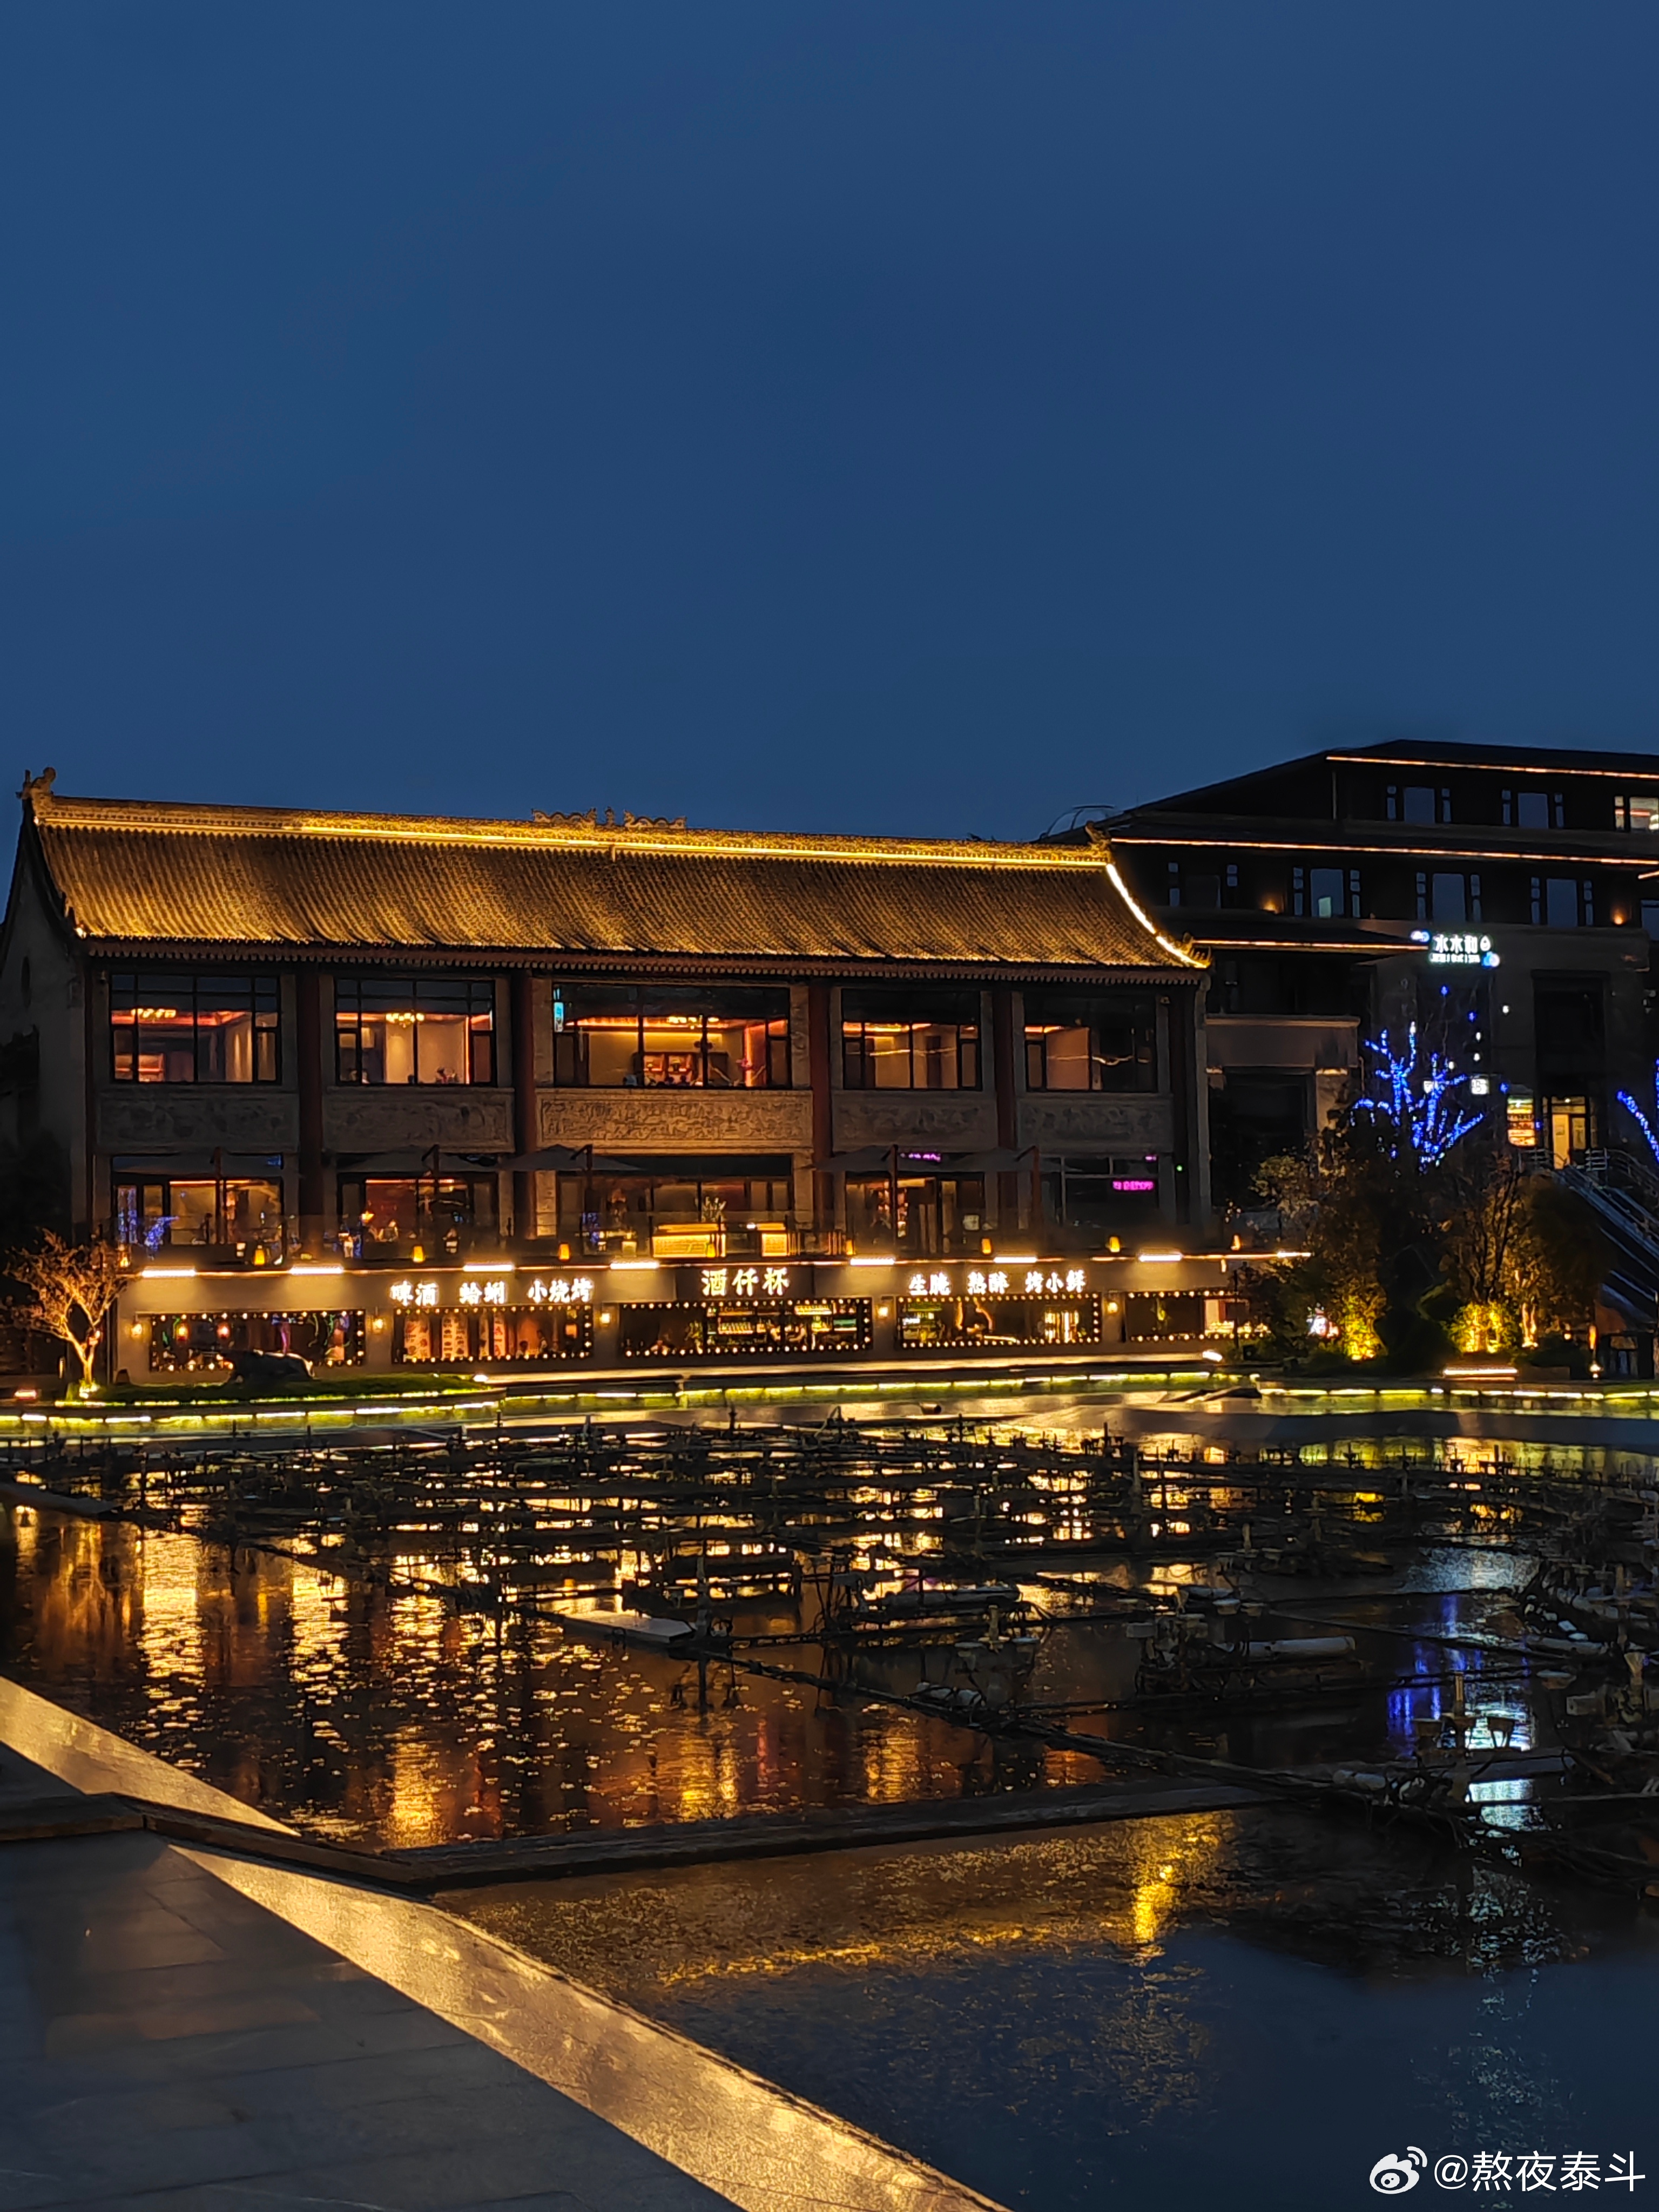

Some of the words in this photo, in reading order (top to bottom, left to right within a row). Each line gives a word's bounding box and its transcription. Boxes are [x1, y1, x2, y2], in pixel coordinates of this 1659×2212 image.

[390, 1280, 438, 1306] 啤酒
[459, 1280, 505, 1305] 蛤蜊
[528, 1277, 594, 1304] 小烧烤
[908, 1271, 951, 1296] 生腌
[1025, 1269, 1086, 1293] 烤小鲜
